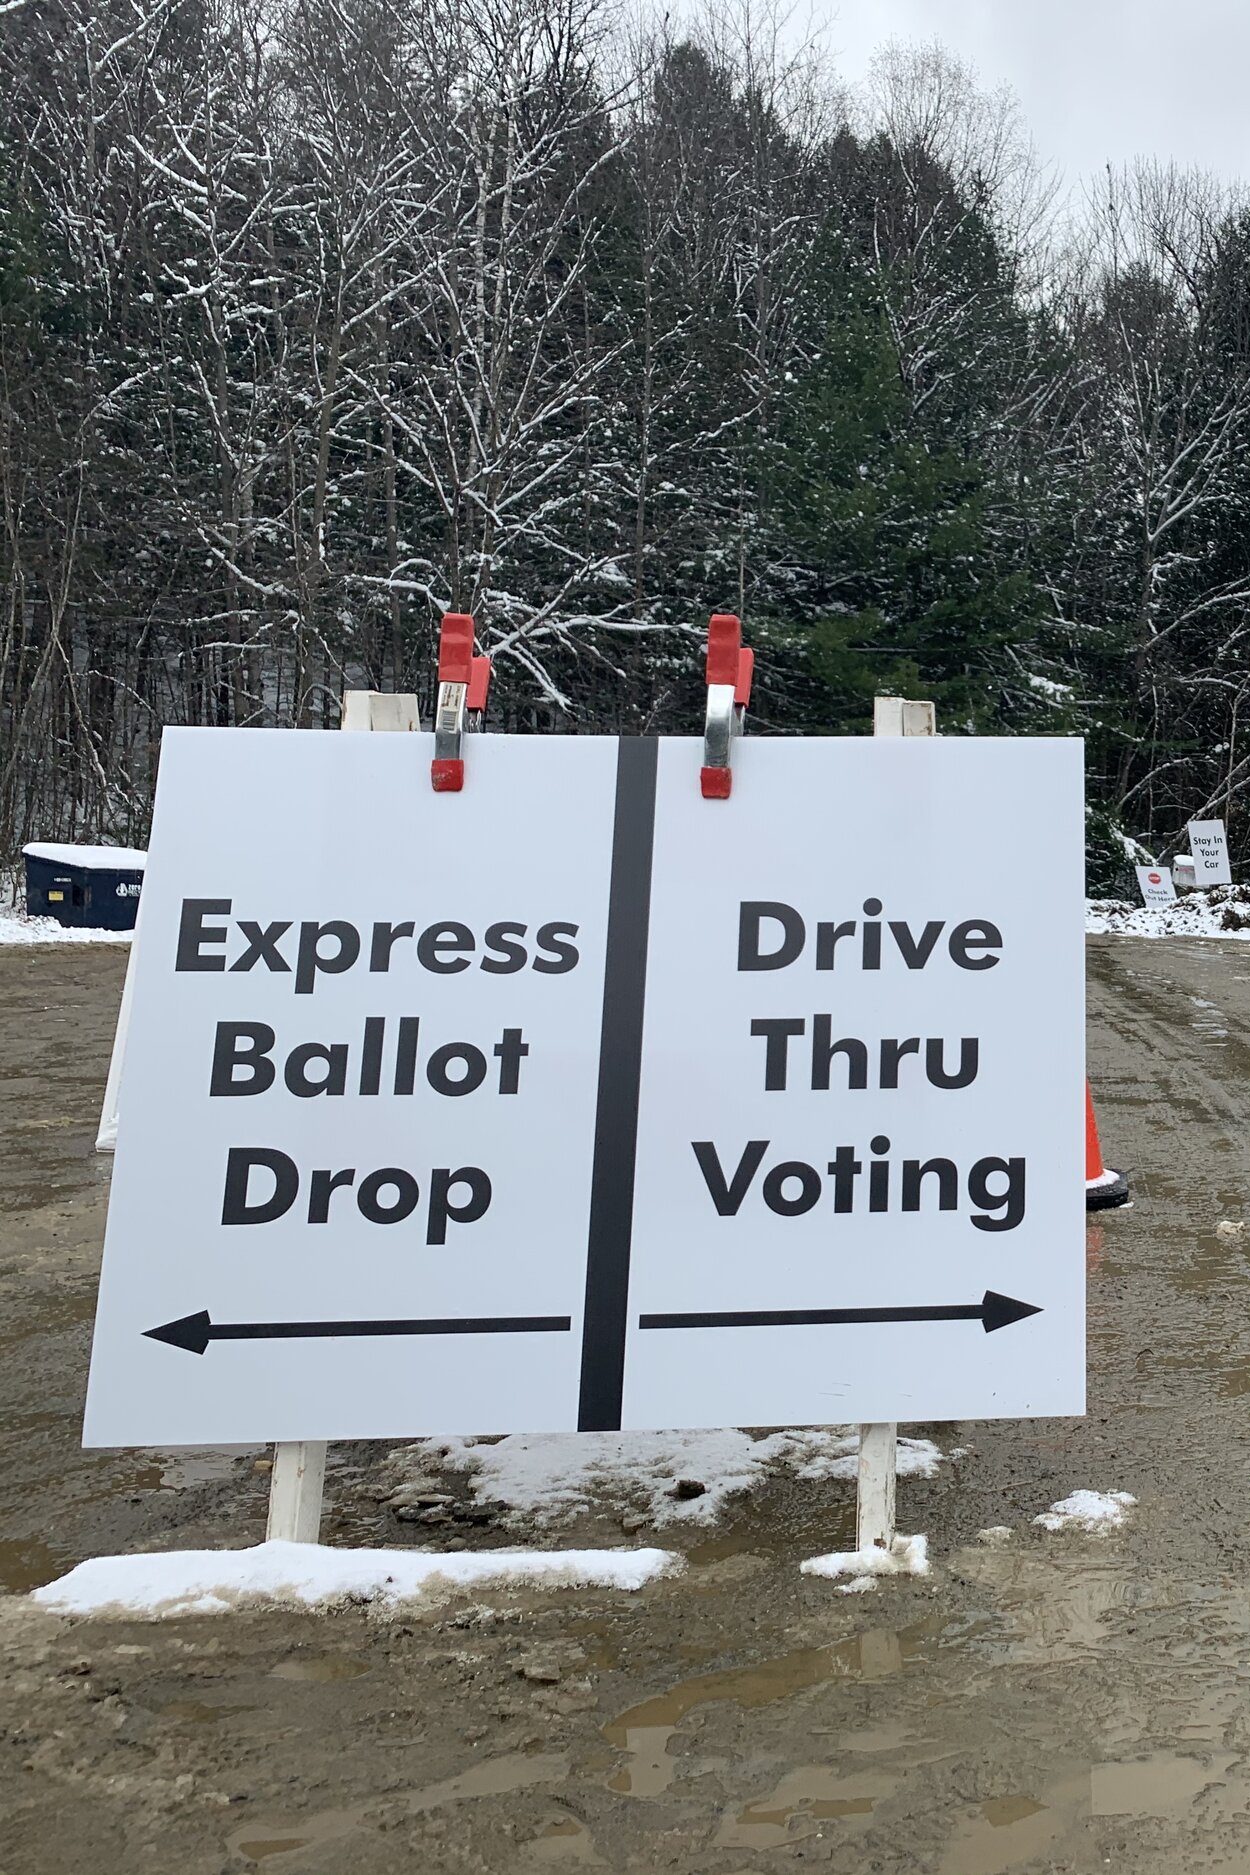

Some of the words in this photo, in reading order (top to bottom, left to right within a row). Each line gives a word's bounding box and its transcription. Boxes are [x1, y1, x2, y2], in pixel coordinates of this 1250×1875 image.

[1193, 836, 1211, 846] Stay
[1213, 835, 1223, 844] In
[1200, 848, 1219, 857] Your
[1204, 860, 1219, 869] Car
[175, 898, 580, 995] Express
[737, 897, 1004, 972] Drive
[210, 1016, 530, 1098] Ballot
[750, 1013, 980, 1092] Thru
[220, 1146, 493, 1246] Drop
[690, 1134, 1026, 1233] Voting
